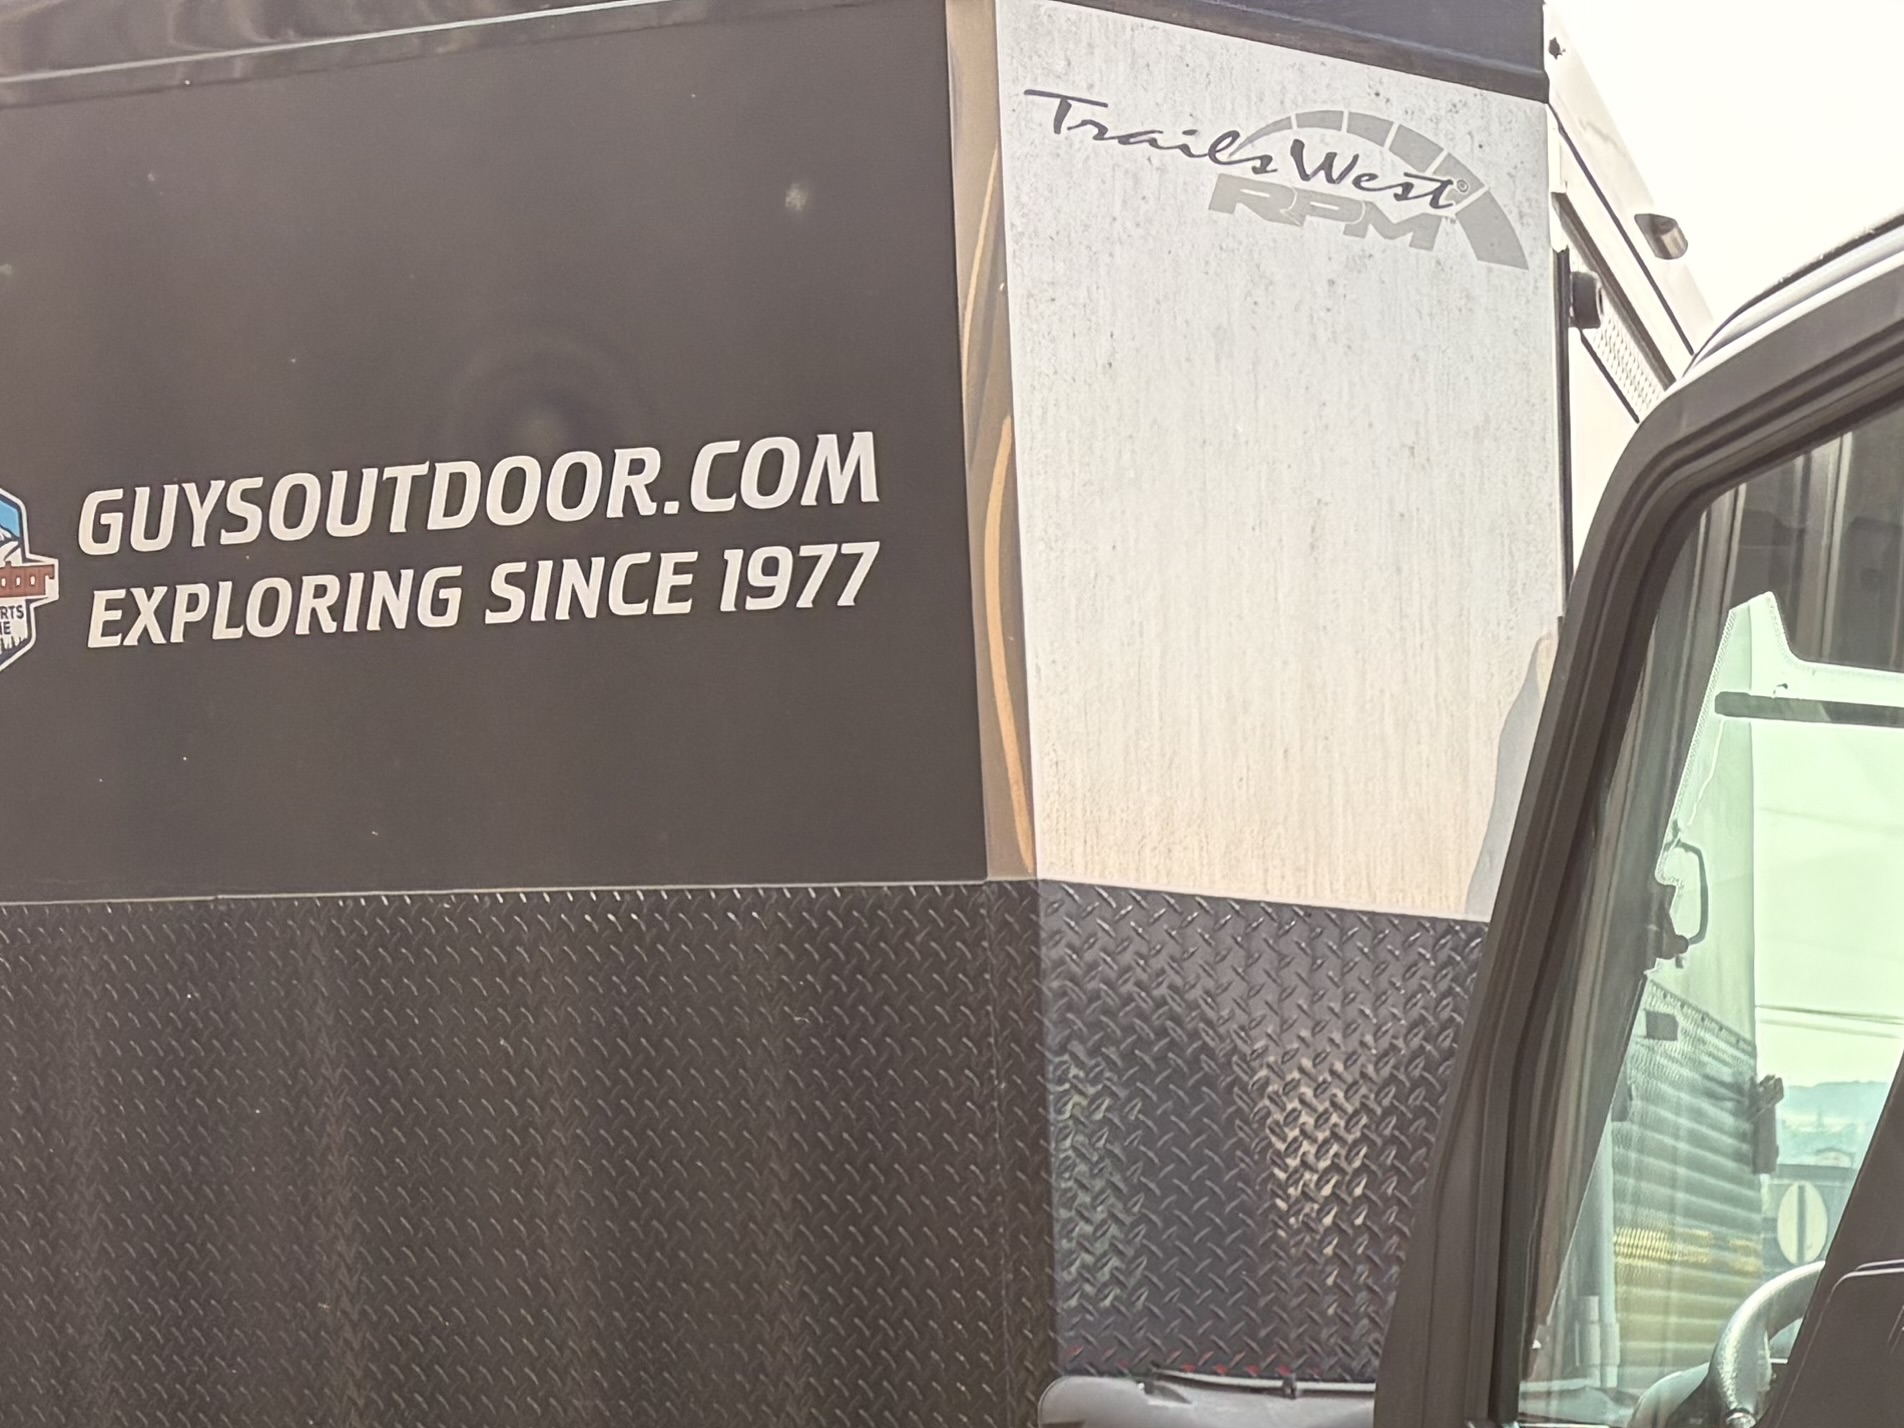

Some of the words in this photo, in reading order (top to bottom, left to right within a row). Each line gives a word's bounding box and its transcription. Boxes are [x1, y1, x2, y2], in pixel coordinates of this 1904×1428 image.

[1024, 89, 1278, 173] Trails
[1290, 139, 1454, 209] West
[1207, 174, 1443, 251] RPM
[77, 431, 879, 555] GUYSOUTDOOR.COM
[88, 566, 462, 647] EXPLORING
[485, 552, 698, 624] SINCE
[720, 541, 880, 612] 1977
